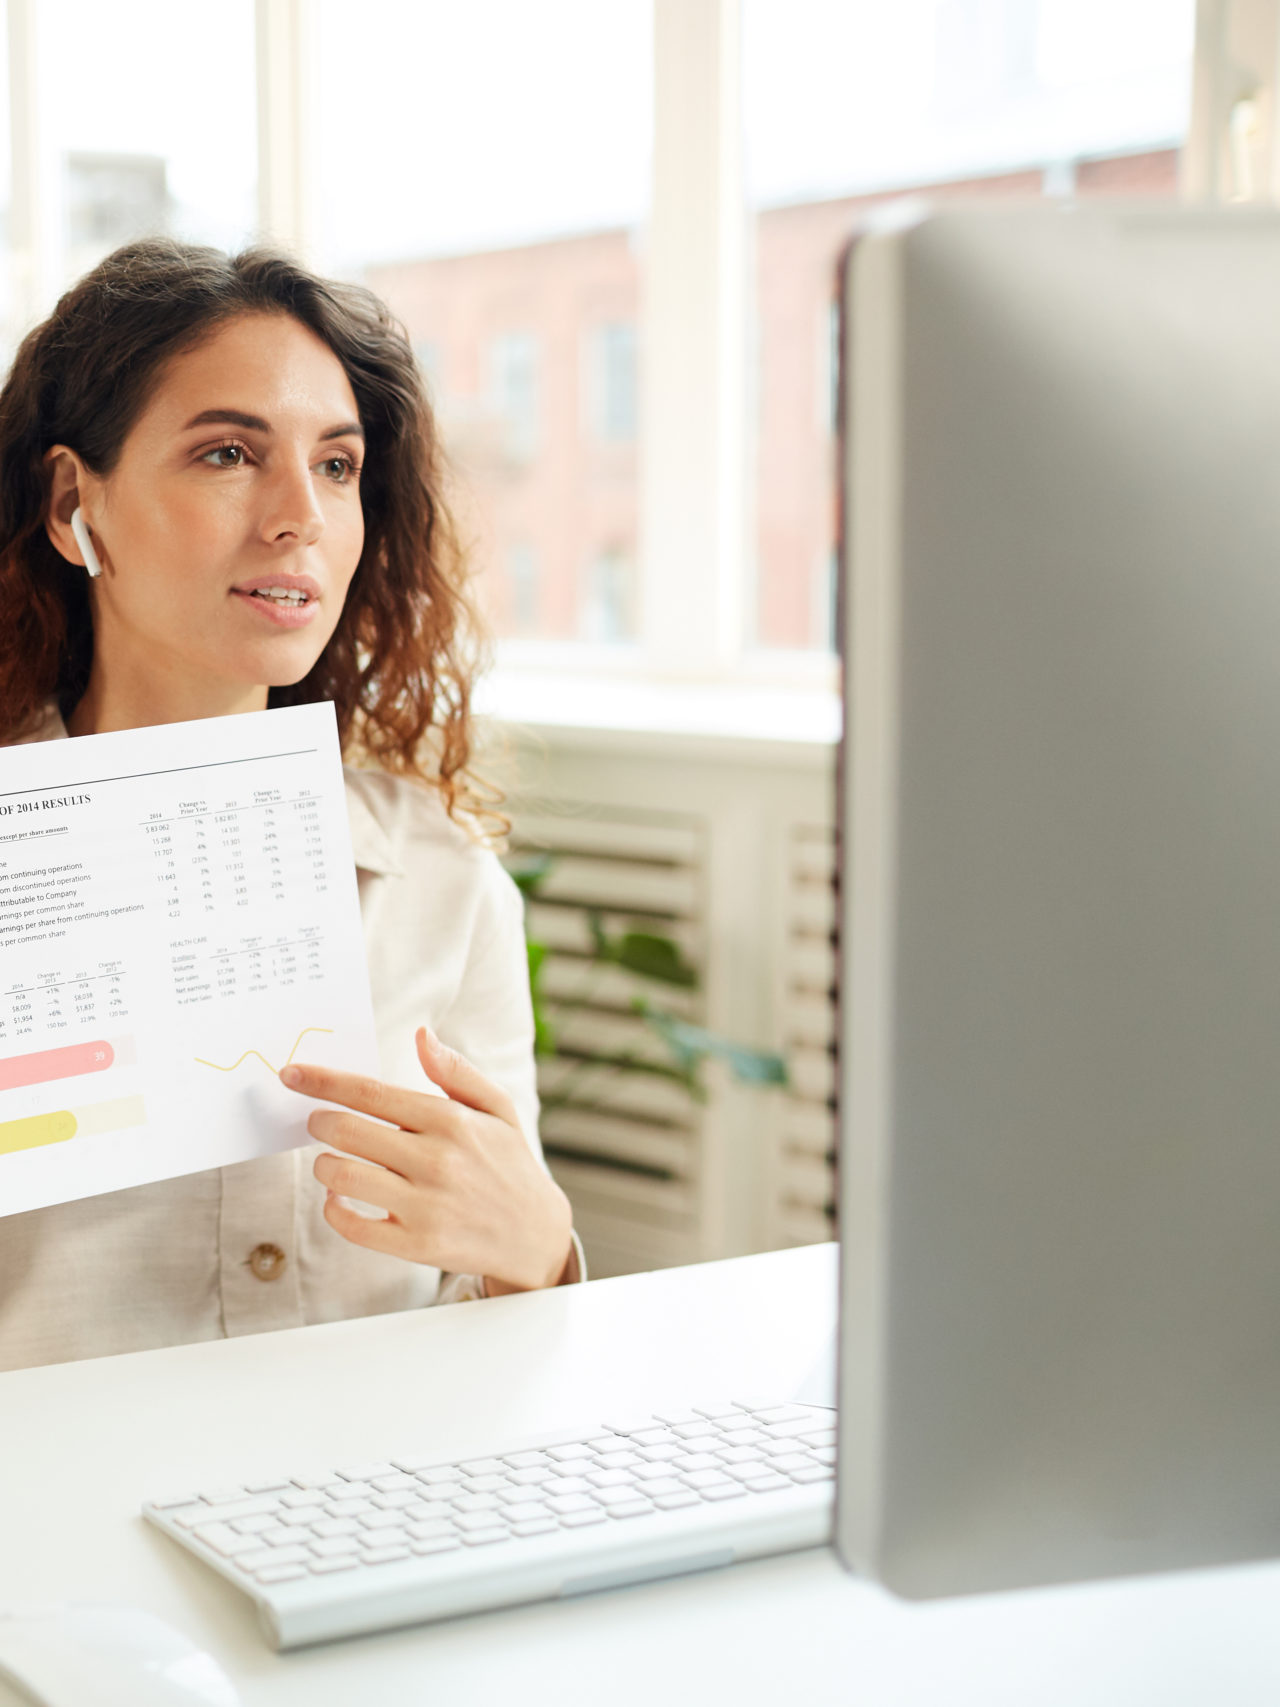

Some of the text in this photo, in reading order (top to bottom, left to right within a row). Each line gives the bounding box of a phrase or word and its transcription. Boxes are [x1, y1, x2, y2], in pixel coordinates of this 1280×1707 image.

[16, 801, 39, 814] 2014
[41, 794, 91, 810] RESULTS
[0, 833, 18, 841] except
[18, 832, 28, 840] per
[45, 826, 69, 834] amounts
[150, 825, 158, 833] 83
[158, 823, 170, 831] 062
[152, 837, 160, 845] 15
[10, 868, 47, 880] continuing
[47, 863, 83, 875] operations
[165, 873, 176, 881] 643
[12, 878, 56, 893] discontinued
[56, 874, 92, 886] operations
[45, 889, 77, 900] Company
[23, 909, 35, 918] per
[36, 904, 66, 915] common
[66, 901, 85, 910] share
[25, 922, 37, 931] per
[38, 919, 56, 928] share
[56, 916, 73, 924] from
[74, 910, 110, 921] continuing
[110, 904, 145, 916] operations
[4, 938, 16, 948] per
[17, 933, 47, 944] common
[48, 930, 66, 939] share
[13, 1014, 33, 1024] $1,954
